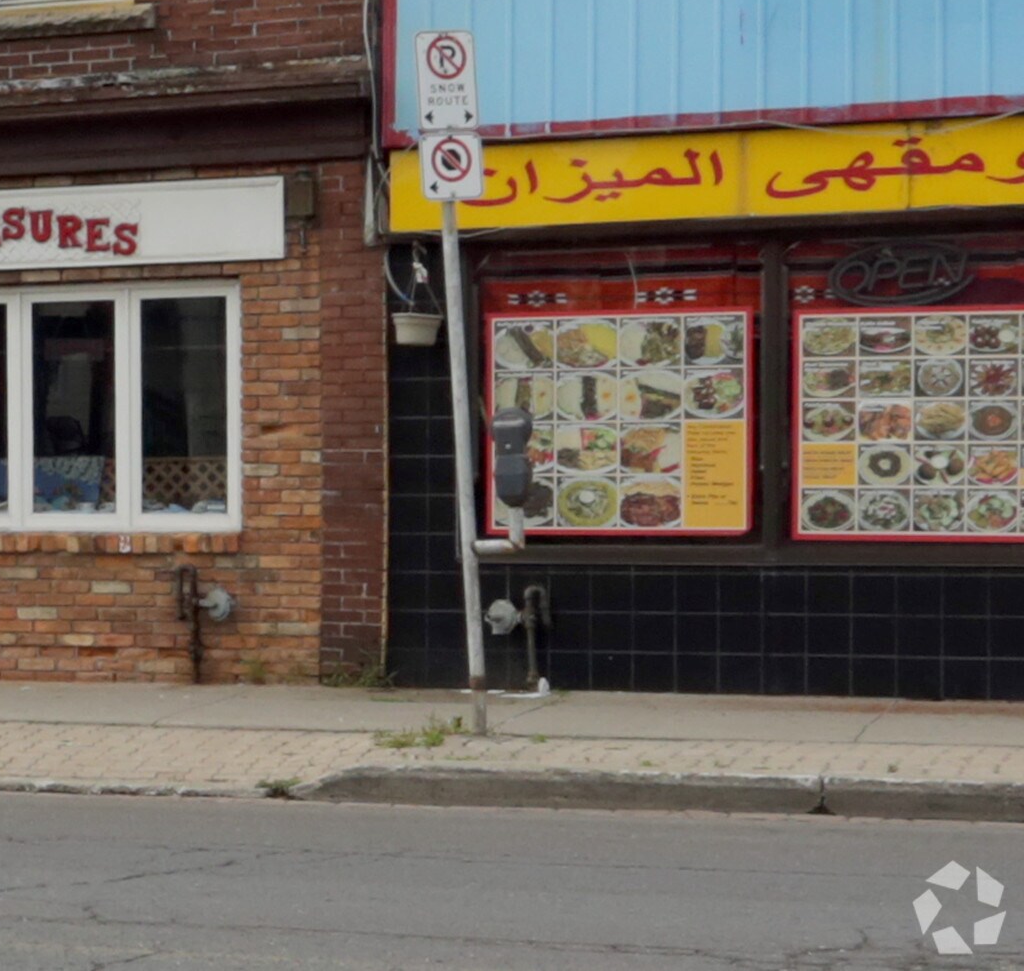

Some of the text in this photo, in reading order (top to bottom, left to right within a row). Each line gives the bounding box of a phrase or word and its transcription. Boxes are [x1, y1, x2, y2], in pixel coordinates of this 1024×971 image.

[430, 84, 465, 94] SNOW
[427, 95, 469, 106] ROUTE
[836, 252, 968, 295] OPEN
